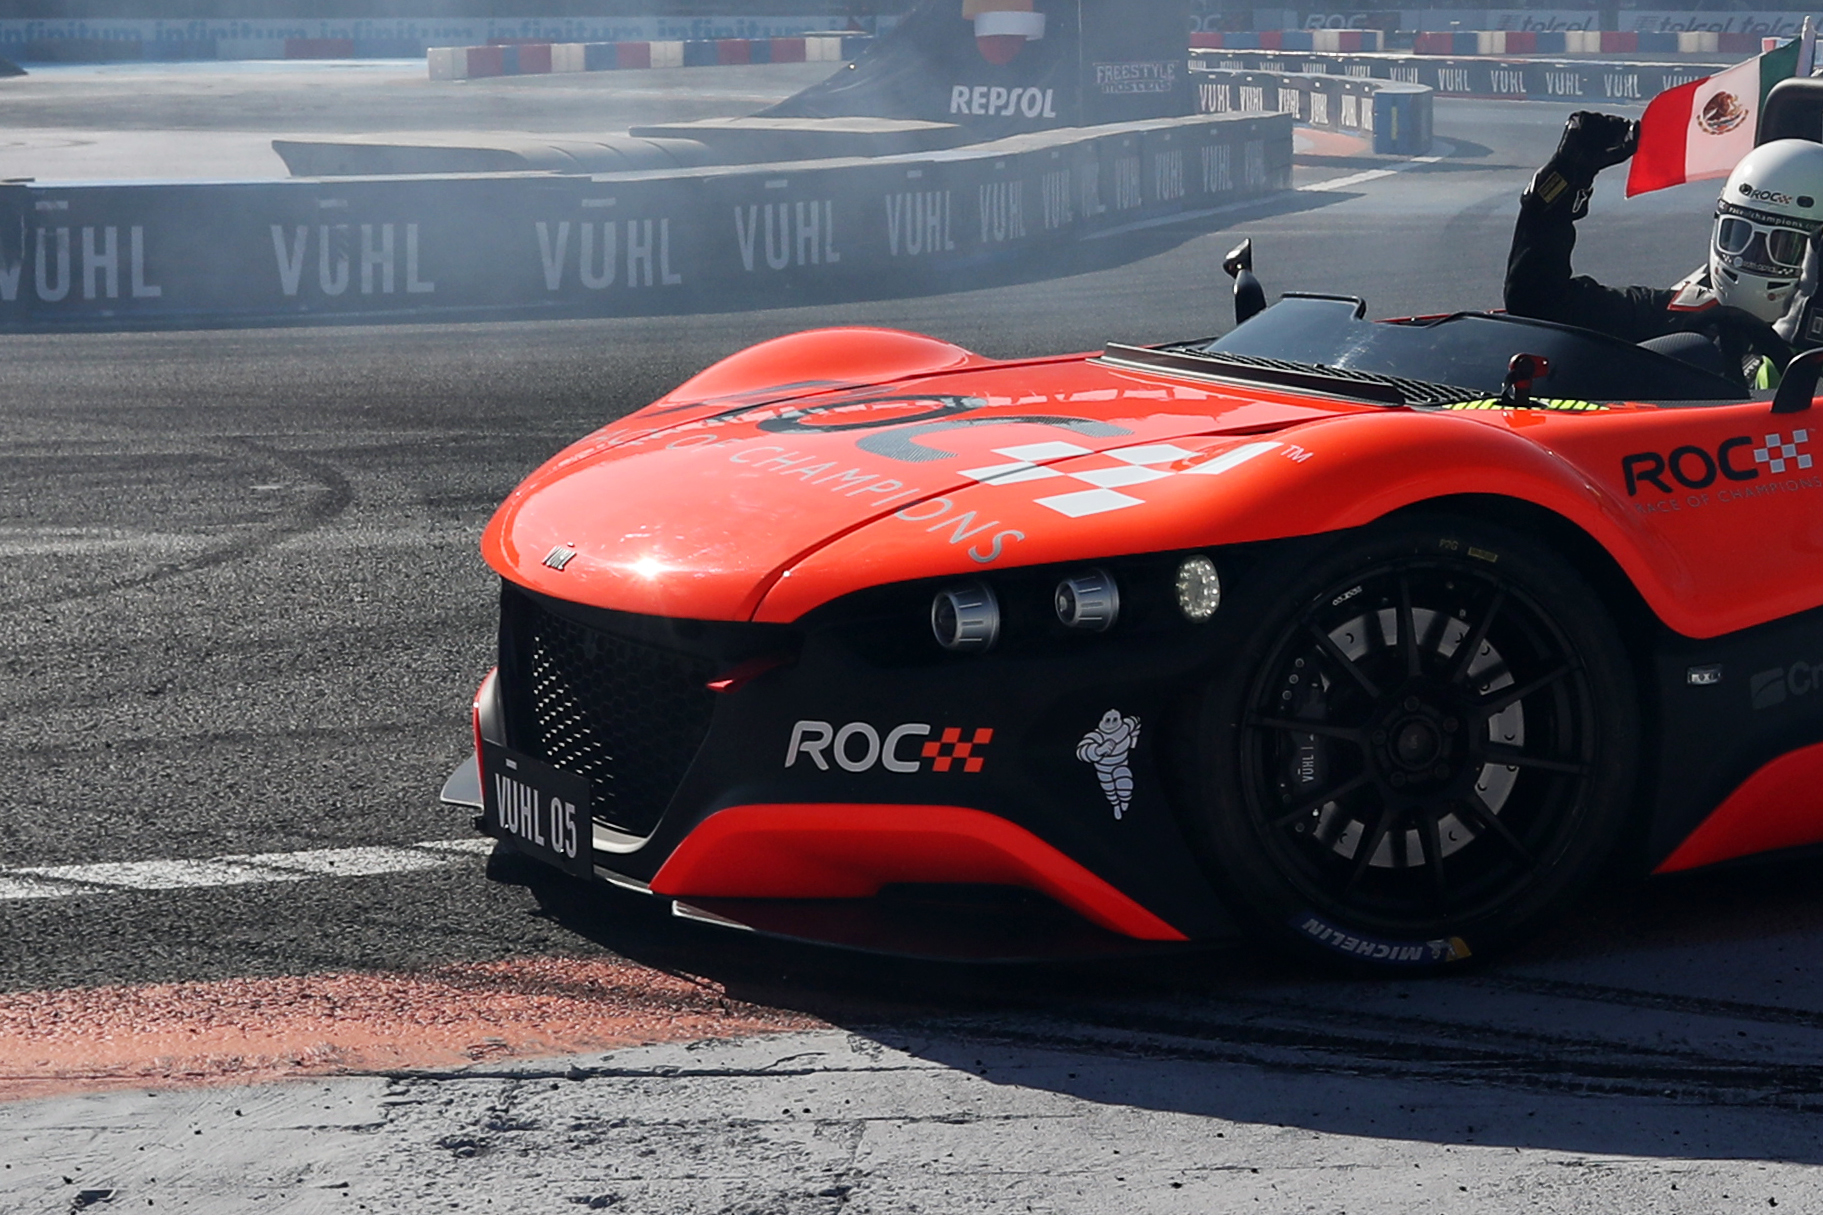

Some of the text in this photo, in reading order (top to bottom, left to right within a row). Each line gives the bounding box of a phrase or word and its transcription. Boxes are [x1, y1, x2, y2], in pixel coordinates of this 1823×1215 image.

[1095, 62, 1176, 82] FREESTYLE
[949, 86, 1057, 118] REPSOL
[1751, 189, 1782, 206] ROC
[1621, 435, 1760, 498] ROC
[729, 444, 1025, 563] CHAMPIONS
[1634, 475, 1823, 515] RACE OF CHAMPIONS
[785, 720, 931, 772] ROC
[551, 797, 577, 859] 05
[1301, 917, 1424, 961] MICHELIN
